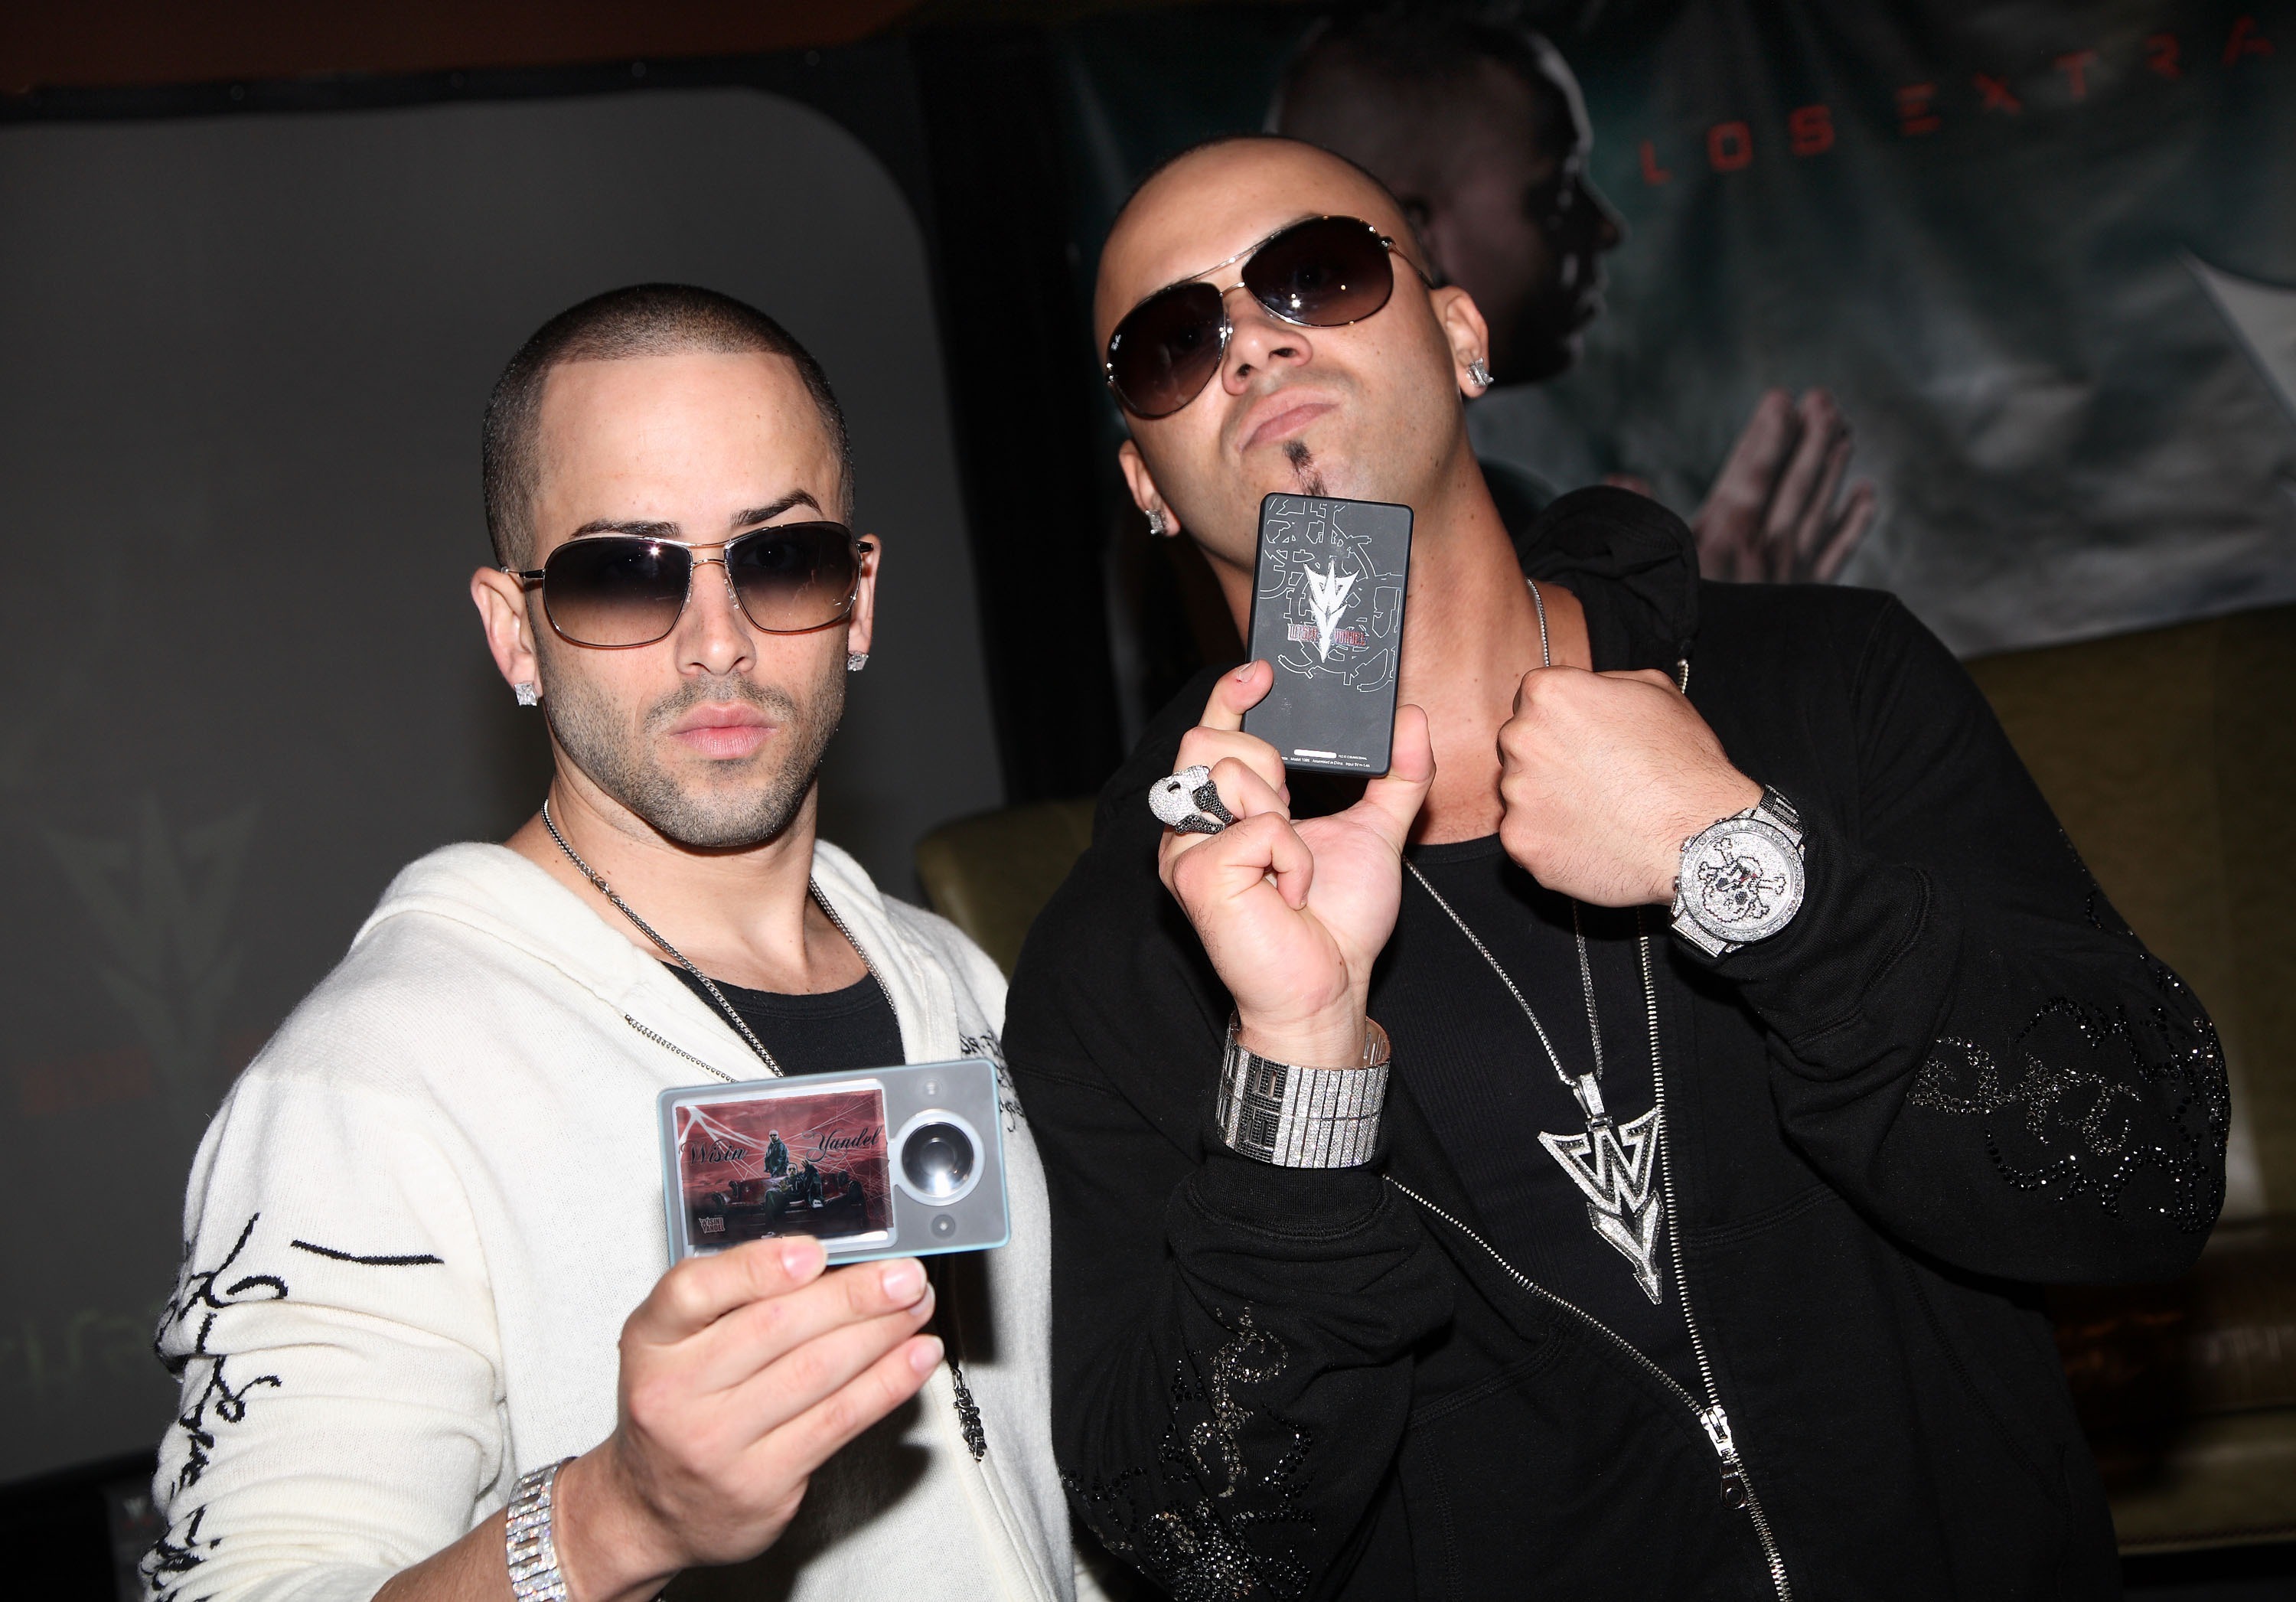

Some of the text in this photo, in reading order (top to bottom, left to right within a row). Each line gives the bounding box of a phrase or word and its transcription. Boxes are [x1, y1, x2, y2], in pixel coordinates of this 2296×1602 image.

[1640, 15, 2275, 185] LOS EXTRA
[680, 1125, 882, 1165] Wisin Yandel
[701, 1224, 726, 1234] YANDEL
